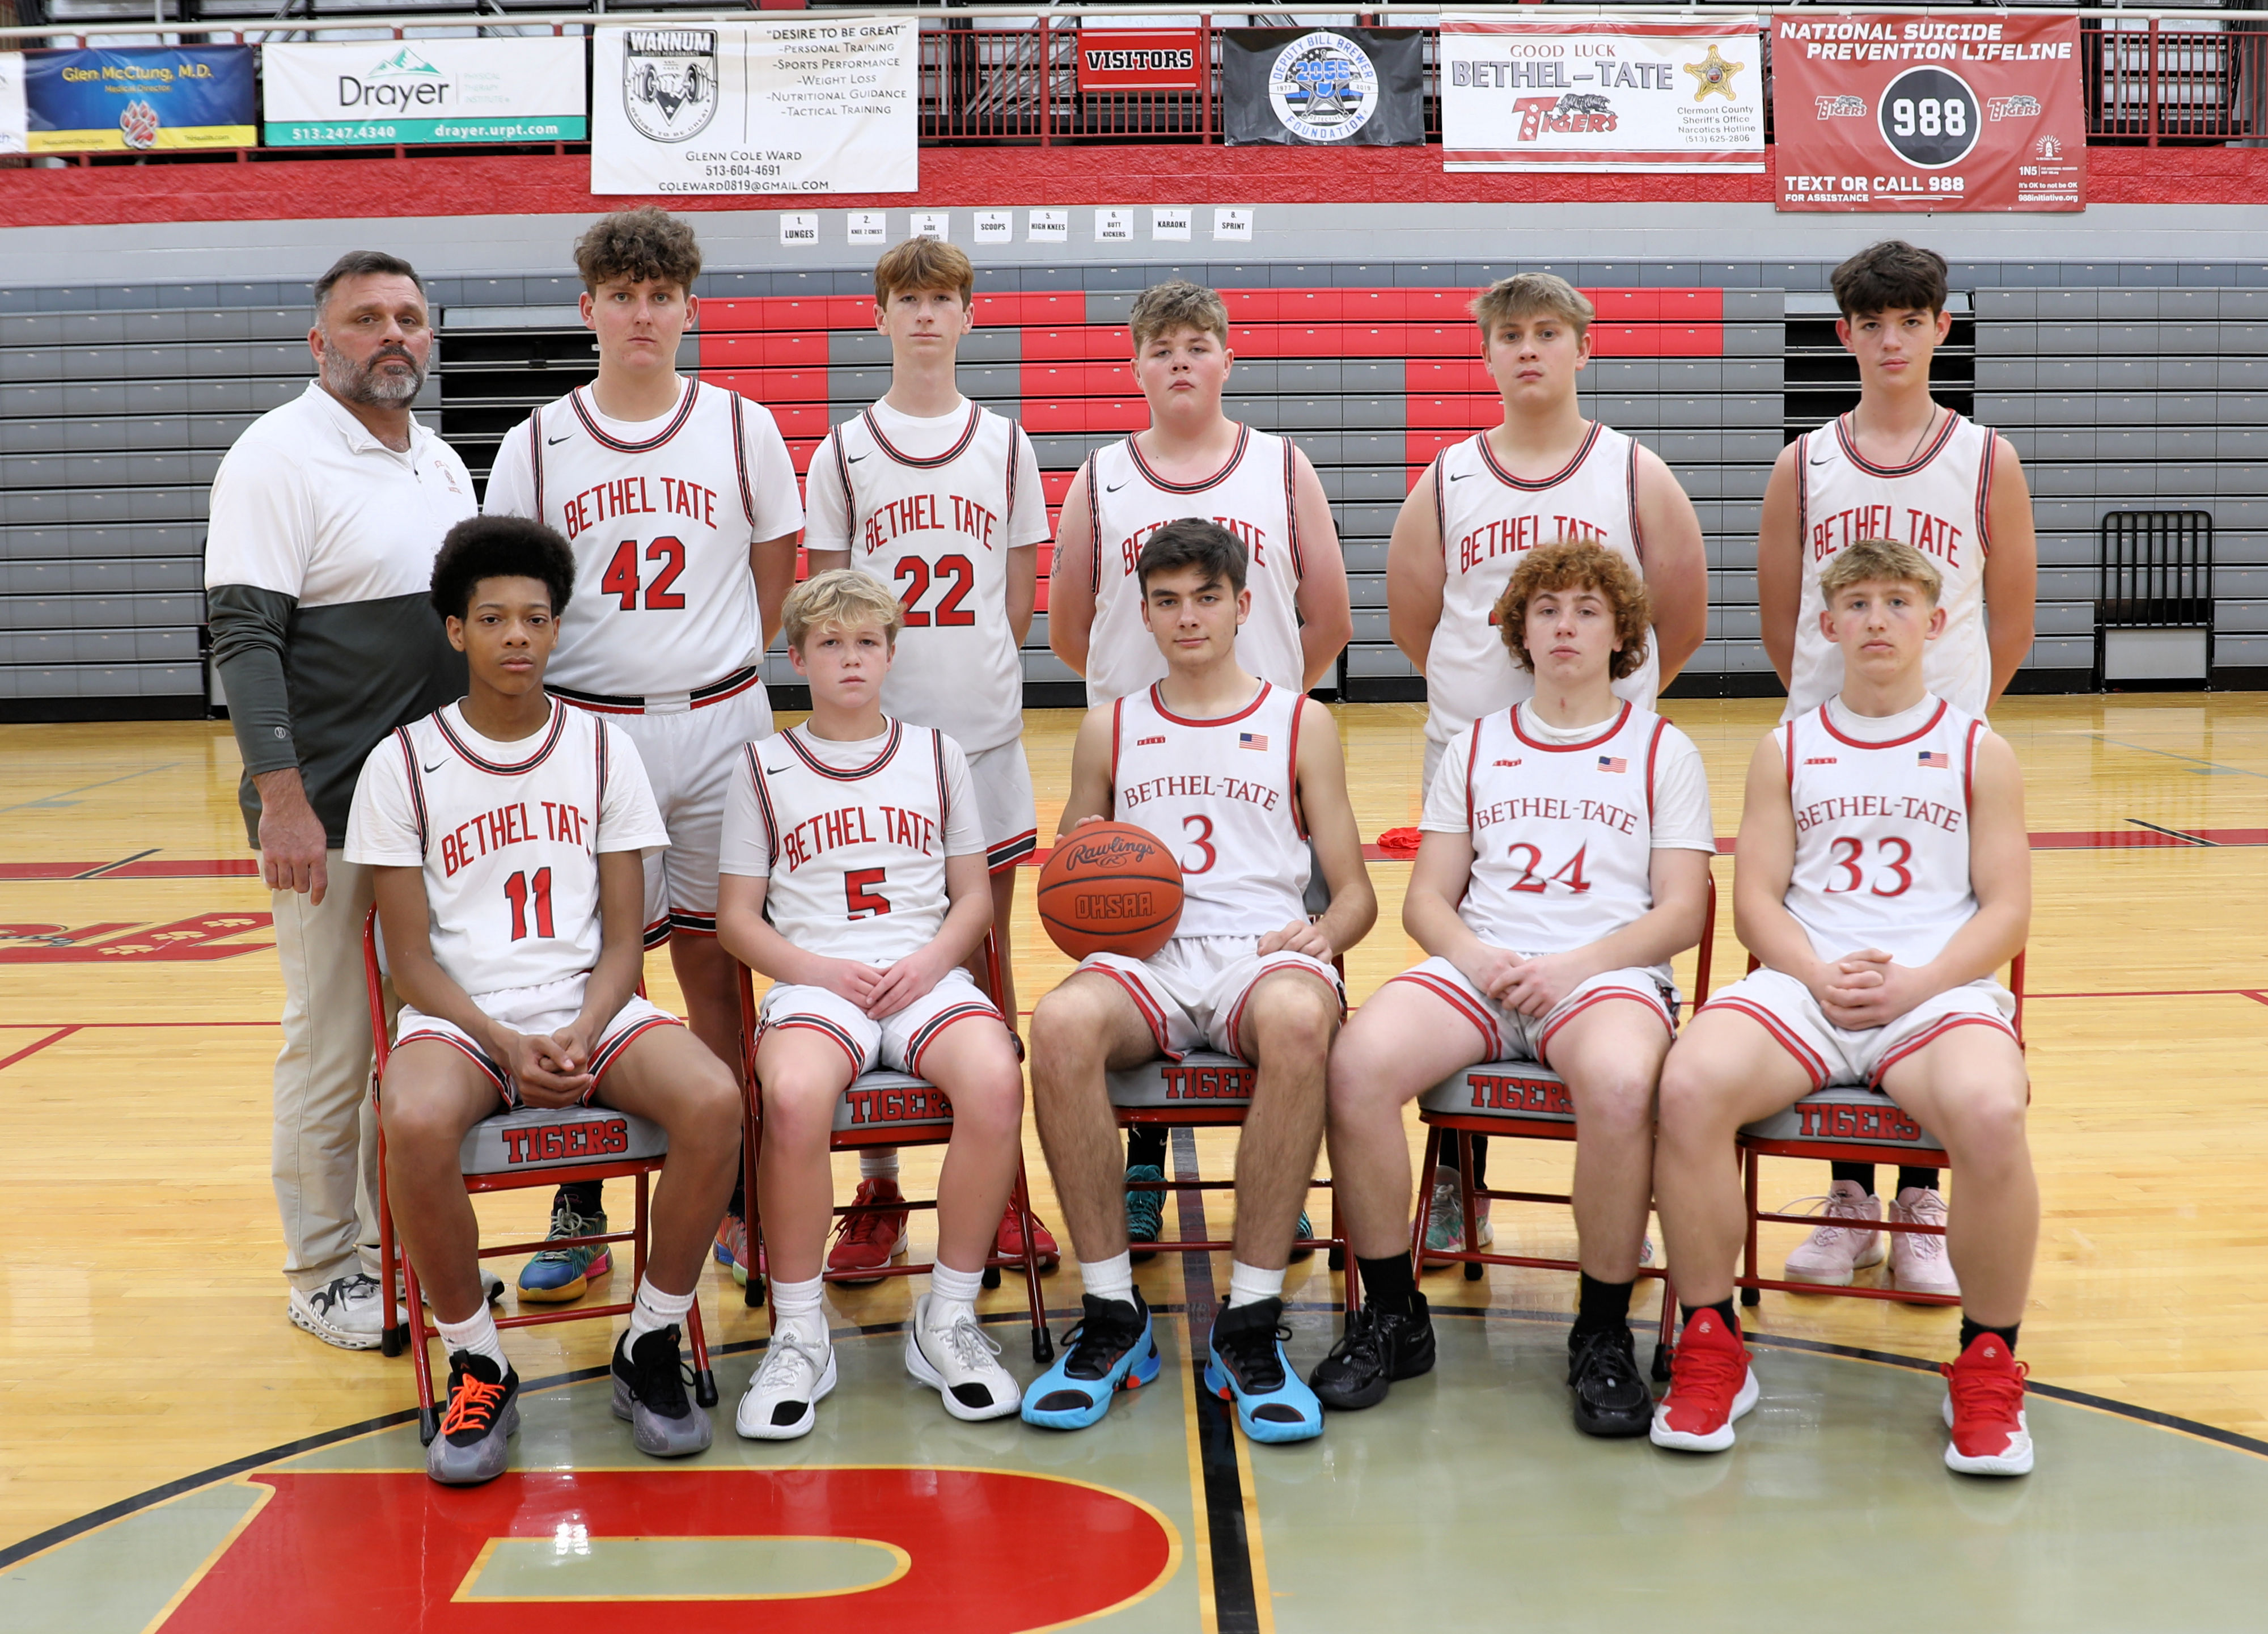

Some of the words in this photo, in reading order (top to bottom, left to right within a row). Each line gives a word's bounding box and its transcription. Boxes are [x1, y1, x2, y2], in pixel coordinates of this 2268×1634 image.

[630, 32, 712, 52] WANNUM
[819, 28, 837, 39] TO
[841, 27, 857, 39] BE
[1780, 23, 1897, 41] NATIONAL
[1903, 23, 2003, 41] SUICIDE
[842, 41, 894, 53] TRAINING
[1084, 49, 1193, 70] VISITORS
[1273, 41, 1304, 80] DEPUTY
[1307, 35, 1332, 47] BILL
[1336, 39, 1373, 79] BREWER
[1510, 44, 1564, 57] GOOD
[1574, 44, 1616, 57] LUCK
[1806, 43, 1956, 60] PREVENTION
[1961, 42, 2072, 60] LIFELINE
[62, 67, 101, 82] Glen
[101, 66, 175, 83] McClung,
[179, 64, 214, 78] M.D.
[822, 58, 900, 69] PERFORMANCE
[1296, 60, 1351, 81] 2055
[1452, 60, 1673, 90] BETHEL-TATE
[850, 74, 877, 84] LOSS
[338, 75, 450, 113] Drayer
[849, 89, 907, 99] GUIDANCE
[840, 104, 891, 115] TRAINING
[1512, 97, 1618, 141] TIGERS
[1677, 106, 1719, 115] Clermont
[1721, 106, 1754, 115] County
[1815, 95, 1867, 120] TIGERS
[1893, 98, 1966, 136] 988
[1987, 96, 2041, 121] TIGERS
[292, 125, 396, 141] 513.247.4340
[434, 124, 558, 139] drayer.urpt.com
[1285, 113, 1365, 138] FOUNDATION
[686, 151, 727, 162] GLENN
[730, 150, 763, 162] COLE
[766, 150, 802, 162] WARD
[705, 164, 781, 176] 513-604-4691
[2019, 166, 2037, 176] 1N5
[658, 180, 830, 192] COLEWARD0819@GMAIL.COM
[1784, 176, 1837, 191] TEXT
[1840, 176, 1868, 191] OR
[1873, 176, 1924, 192] CALL
[1928, 176, 1965, 191] 988
[1805, 193, 1869, 202] ASSISTANCE
[2018, 194, 2079, 203] 988initiative.org
[785, 230, 814, 238] LUNGES
[1222, 222, 1245, 230] SPRINT
[564, 476, 656, 541] BETHEL
[660, 477, 717, 530] TATE
[865, 494, 945, 556] BETHEL
[950, 495, 997, 551] TATE
[1813, 505, 1898, 563] BETHEL
[1907, 508, 1962, 568] TATE
[1461, 515, 1546, 575] BETHEL
[601, 536, 686, 611] 42
[894, 554, 975, 627] 22
[1123, 775, 1279, 812] BETHEL-TATE
[1475, 797, 1637, 835] BETHEL-TATE
[1796, 796, 1962, 833] BETHEL-TATE
[442, 802, 538, 878] BETHEL
[784, 807, 877, 873] BETHEL
[879, 806, 934, 858] TATE
[1180, 814, 1217, 875] 3
[1066, 837, 1155, 871] Rawlings
[1507, 838, 1591, 894] 24
[1823, 835, 1913, 897] 33
[503, 866, 555, 942] 11
[844, 867, 891, 921] 5
[1075, 892, 1152, 919] OHSAA
[1161, 1066, 1258, 1099] TIGER
[1795, 1103, 1920, 1141] TIGERS
[502, 1118, 628, 1164] TIGERS
